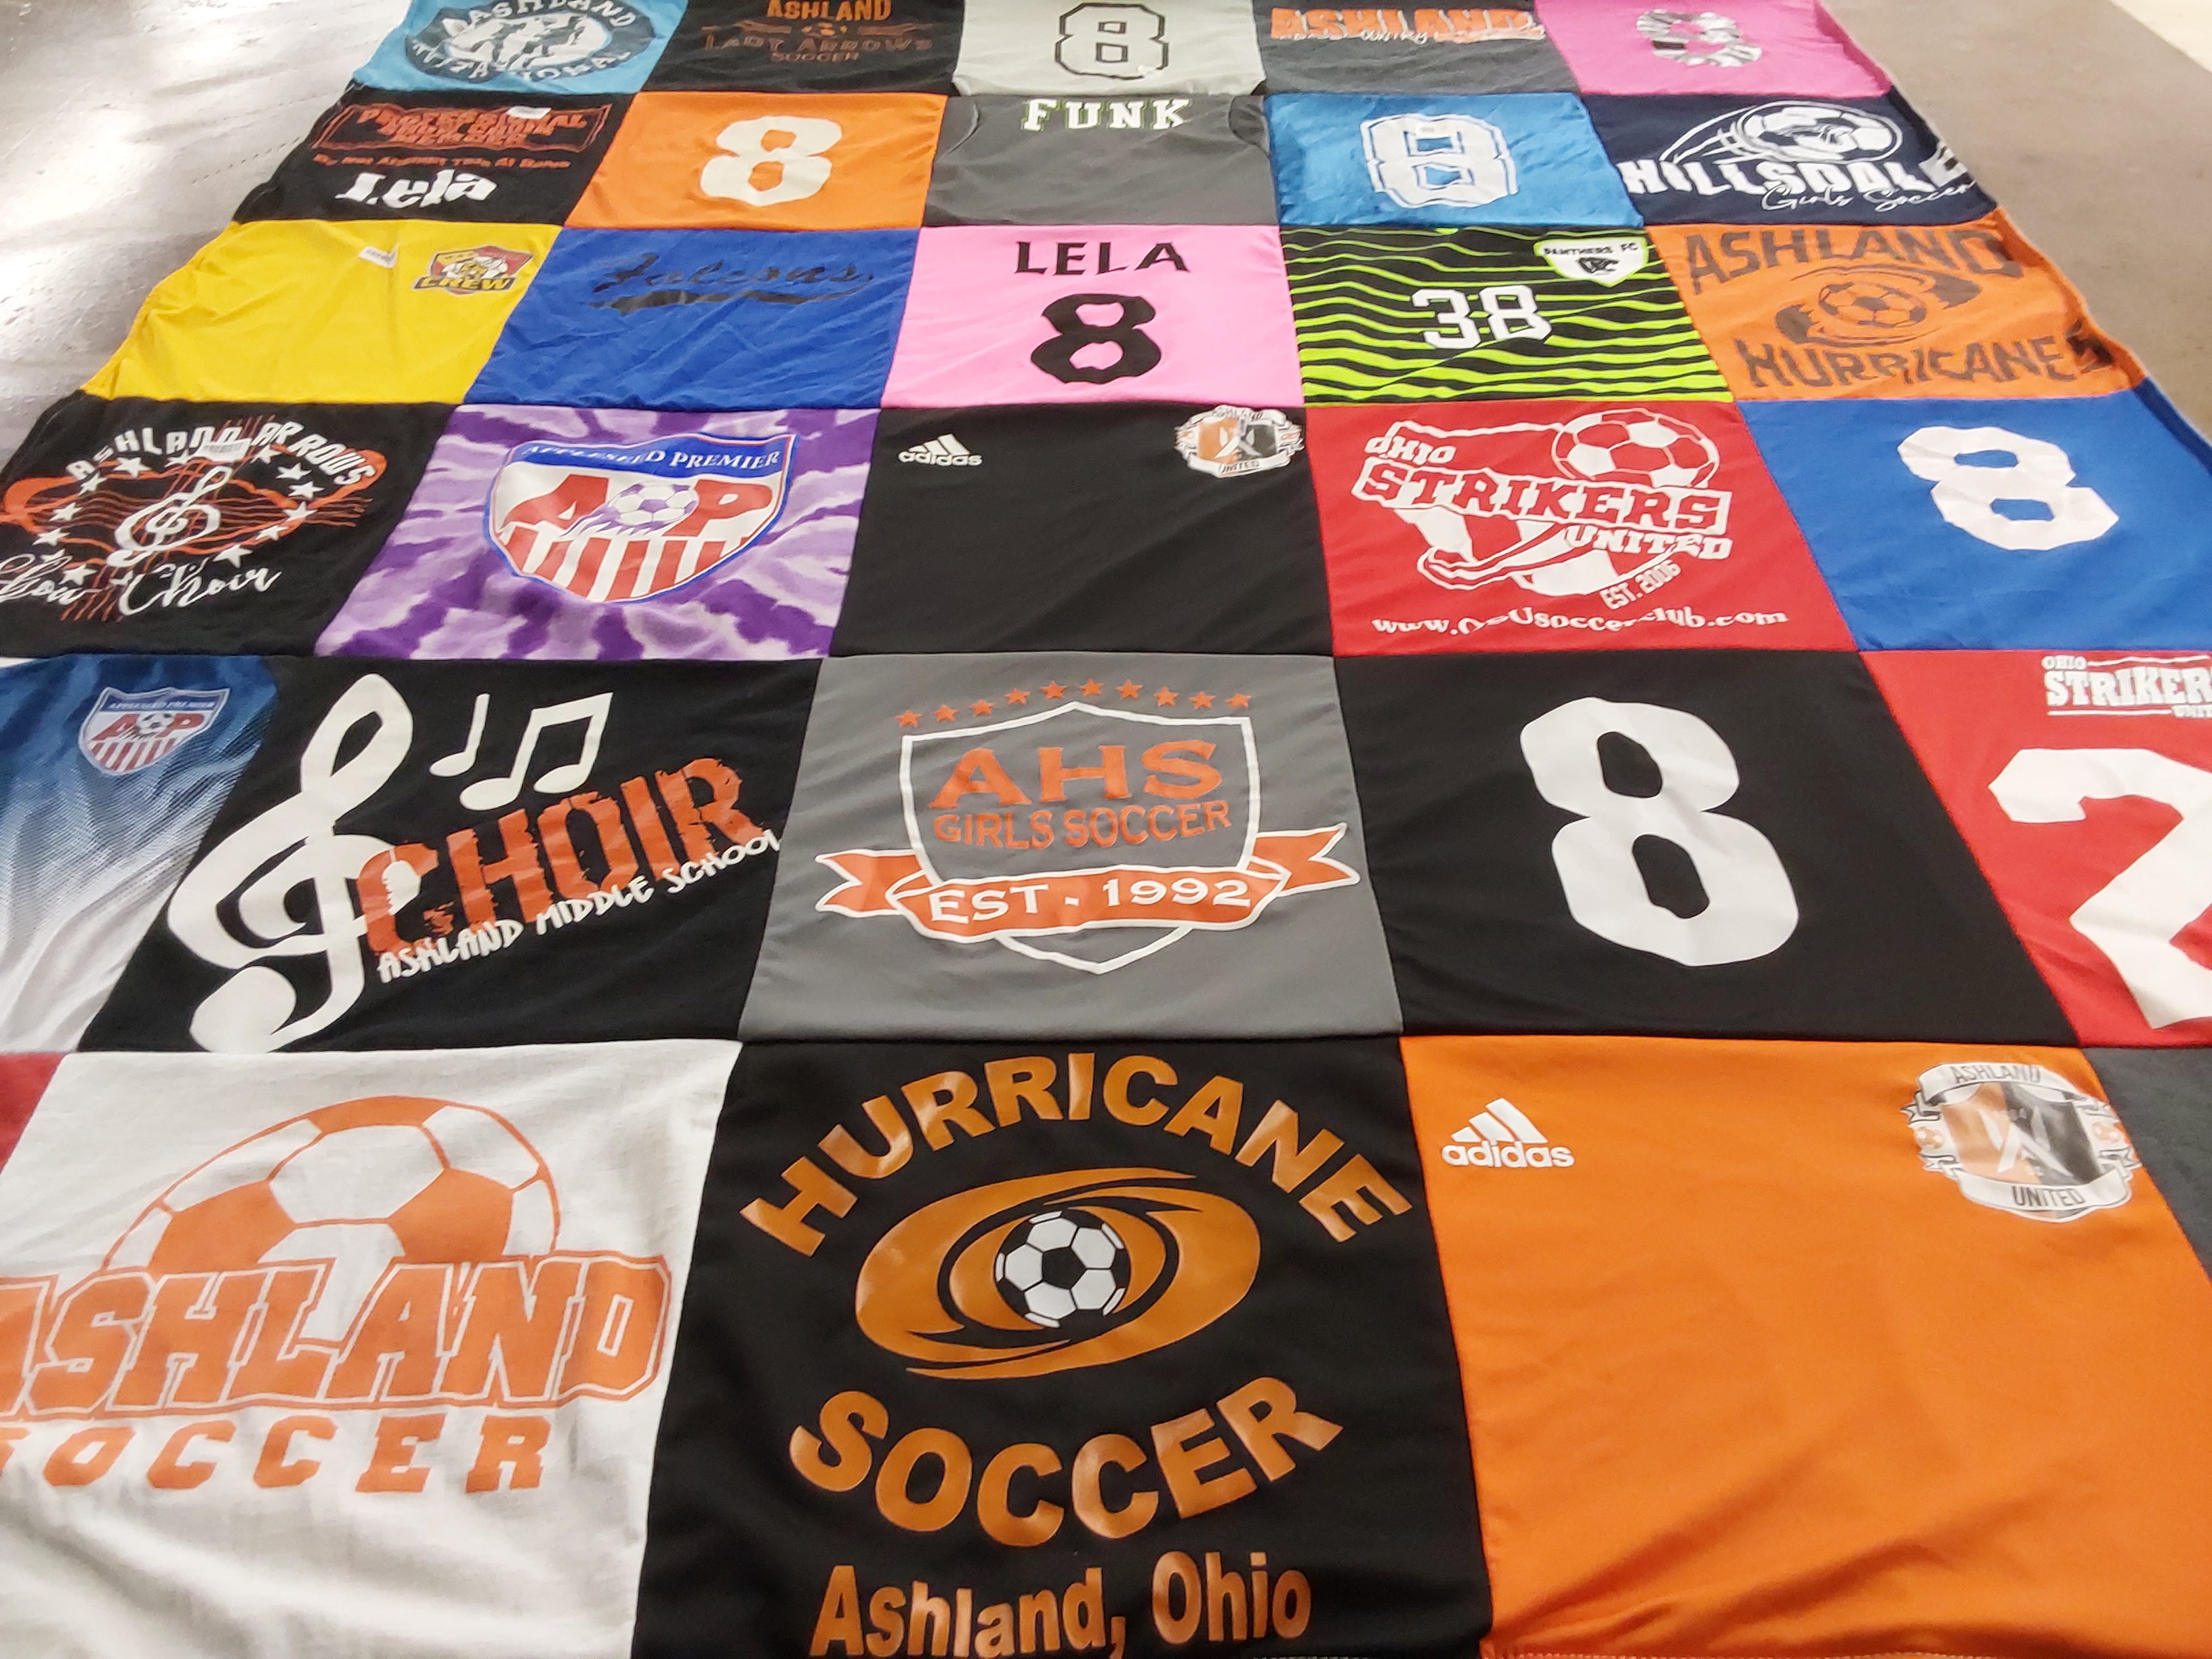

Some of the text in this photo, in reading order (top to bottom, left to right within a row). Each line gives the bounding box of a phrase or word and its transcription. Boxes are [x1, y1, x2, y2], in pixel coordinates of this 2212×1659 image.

[1055, 3, 1169, 80] 8
[1021, 98, 1191, 131] FUNK
[701, 115, 843, 207] 8
[1359, 113, 1519, 209] 8
[1015, 241, 1191, 276] LELA
[1620, 241, 1639, 252] FC
[1685, 228, 2024, 295] ASHLAND
[420, 276, 513, 291] CREW
[1030, 293, 1162, 384] 8
[1412, 284, 1552, 349] 38
[250, 421, 377, 485] ARROWS
[669, 450, 781, 470] PREMIER
[898, 449, 983, 466] adidas
[1359, 461, 1727, 534] STRIKERS
[1898, 425, 2119, 551] 8
[1562, 524, 1733, 560] UNITED
[2041, 654, 2087, 670] OHIO
[2044, 665, 2212, 707] STRIKER
[928, 739, 1223, 809] AHS
[933, 799, 1232, 851] GIRLS SOCCER
[1519, 697, 1799, 967] 8
[356, 757, 770, 960] CHOIR
[376, 828, 782, 984] ASHLAND MIDDLE SCHOOL
[928, 882, 1050, 926] EST
[1103, 877, 1252, 909] 1992
[1949, 1065, 2043, 1084] ASHLAND
[739, 1052, 1413, 1256] HURRICANE
[1441, 1140, 1576, 1168] adidas
[2011, 1185, 2086, 1208] UNITED
[788, 1376, 1344, 1548] SOCCER
[808, 1551, 1312, 1658] Ashland, Ohio
